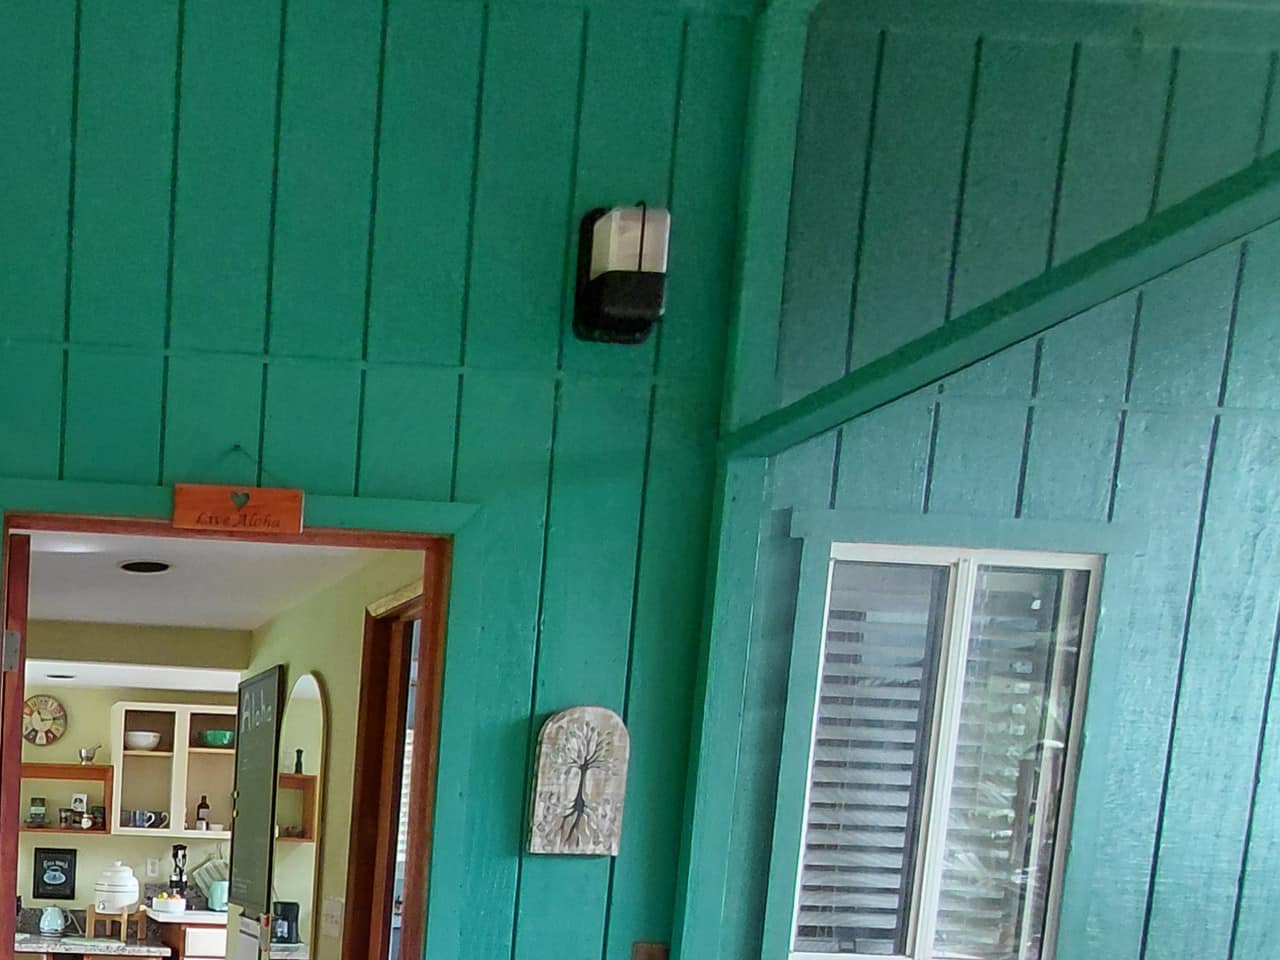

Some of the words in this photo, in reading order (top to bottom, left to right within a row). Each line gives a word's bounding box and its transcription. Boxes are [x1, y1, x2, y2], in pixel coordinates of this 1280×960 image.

[196, 511, 231, 526] Live
[232, 512, 281, 529] Aloha
[241, 688, 272, 733] Aloha
